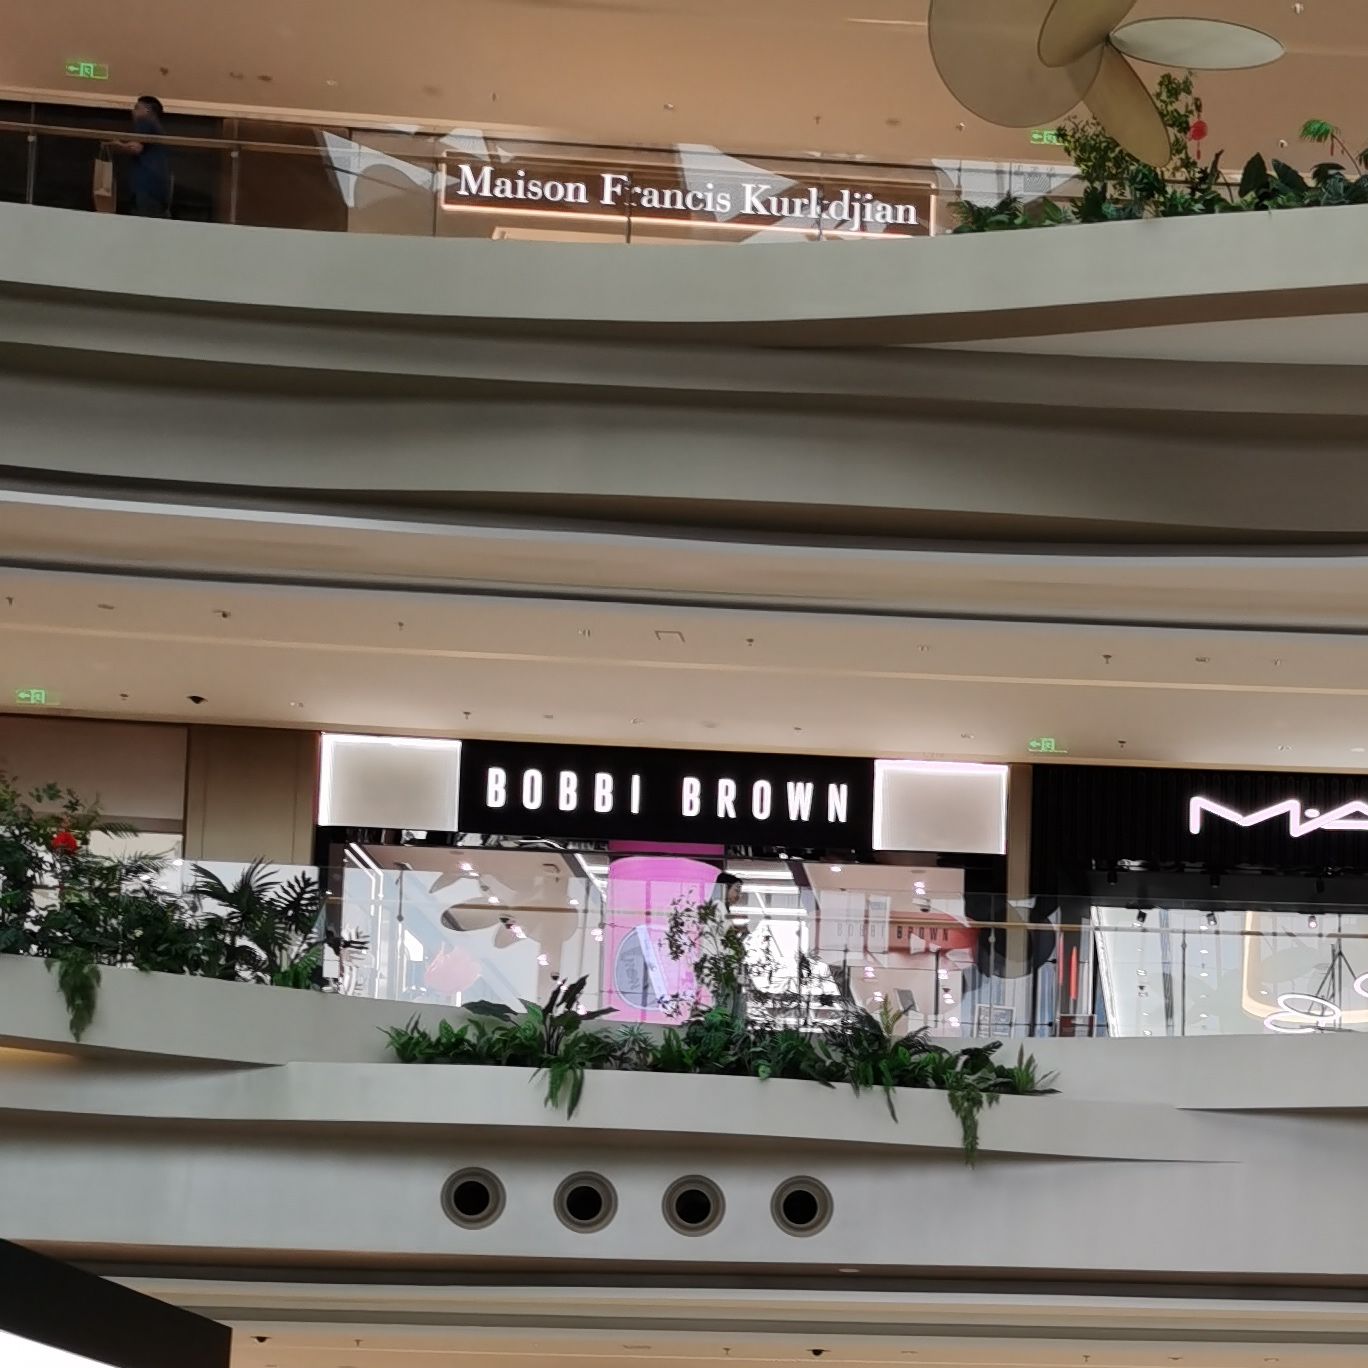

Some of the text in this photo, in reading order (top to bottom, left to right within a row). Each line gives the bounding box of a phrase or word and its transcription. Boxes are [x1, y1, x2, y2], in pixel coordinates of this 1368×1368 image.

[457, 164, 589, 203] Maison
[600, 173, 731, 213] Francis
[486, 766, 849, 823] BOBBI BROWN
